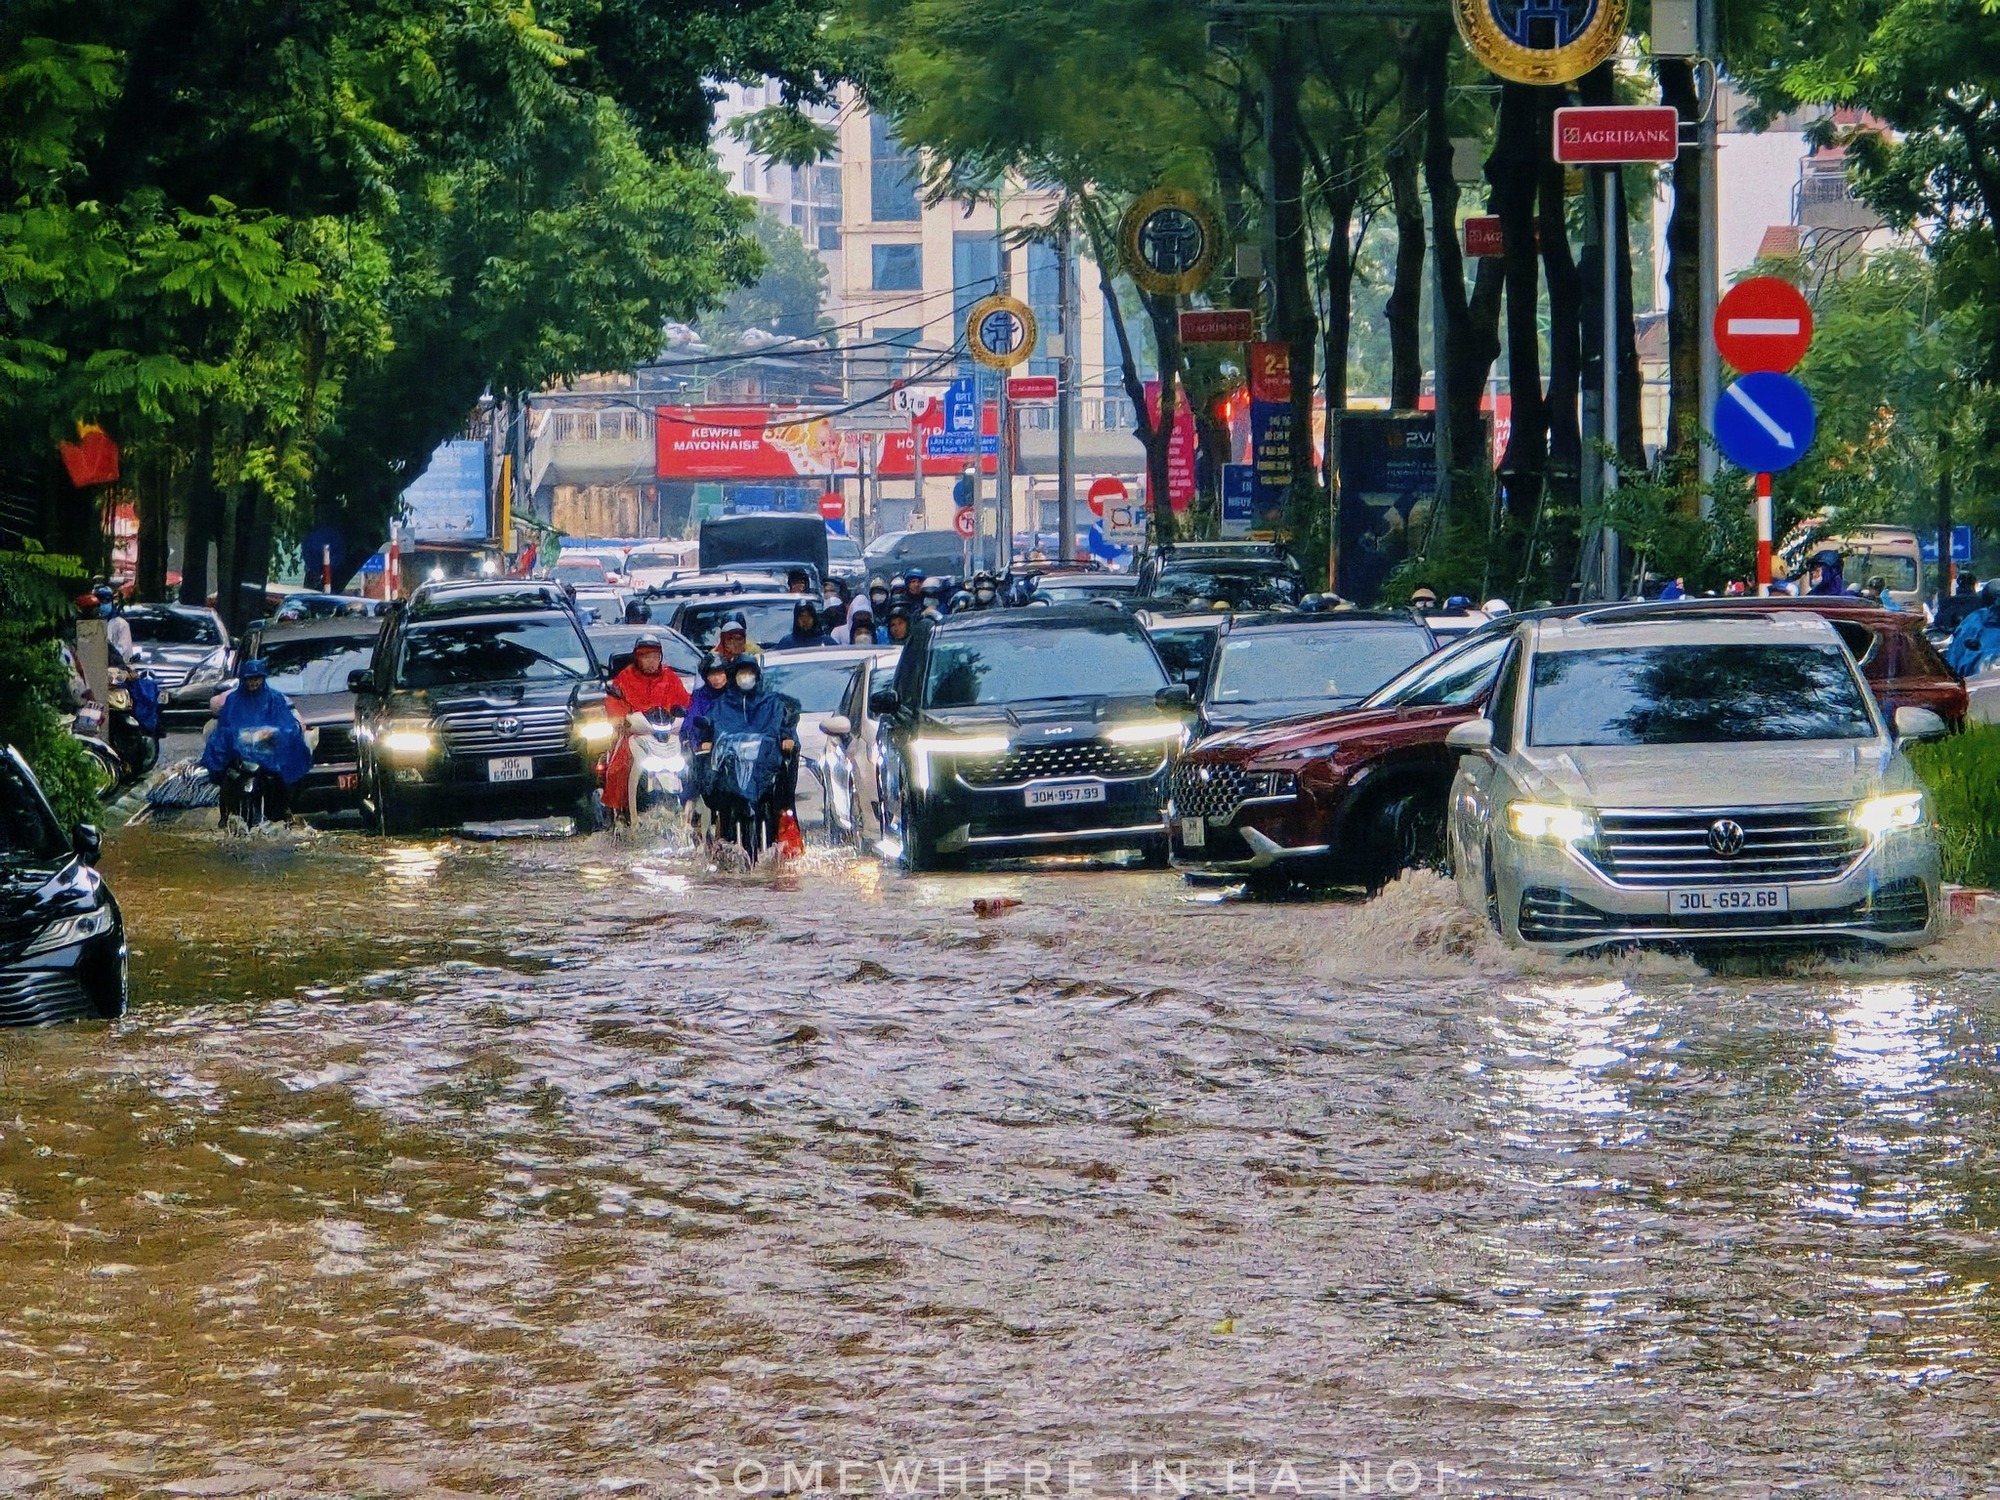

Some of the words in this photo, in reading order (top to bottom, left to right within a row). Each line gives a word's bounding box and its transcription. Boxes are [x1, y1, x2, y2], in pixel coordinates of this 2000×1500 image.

[1582, 128, 1670, 143] AGRIBANK
[691, 428, 741, 438] KEWPIE
[673, 440, 759, 451] MAYONNAISE
[1679, 891, 1778, 909] 30L-692.68
